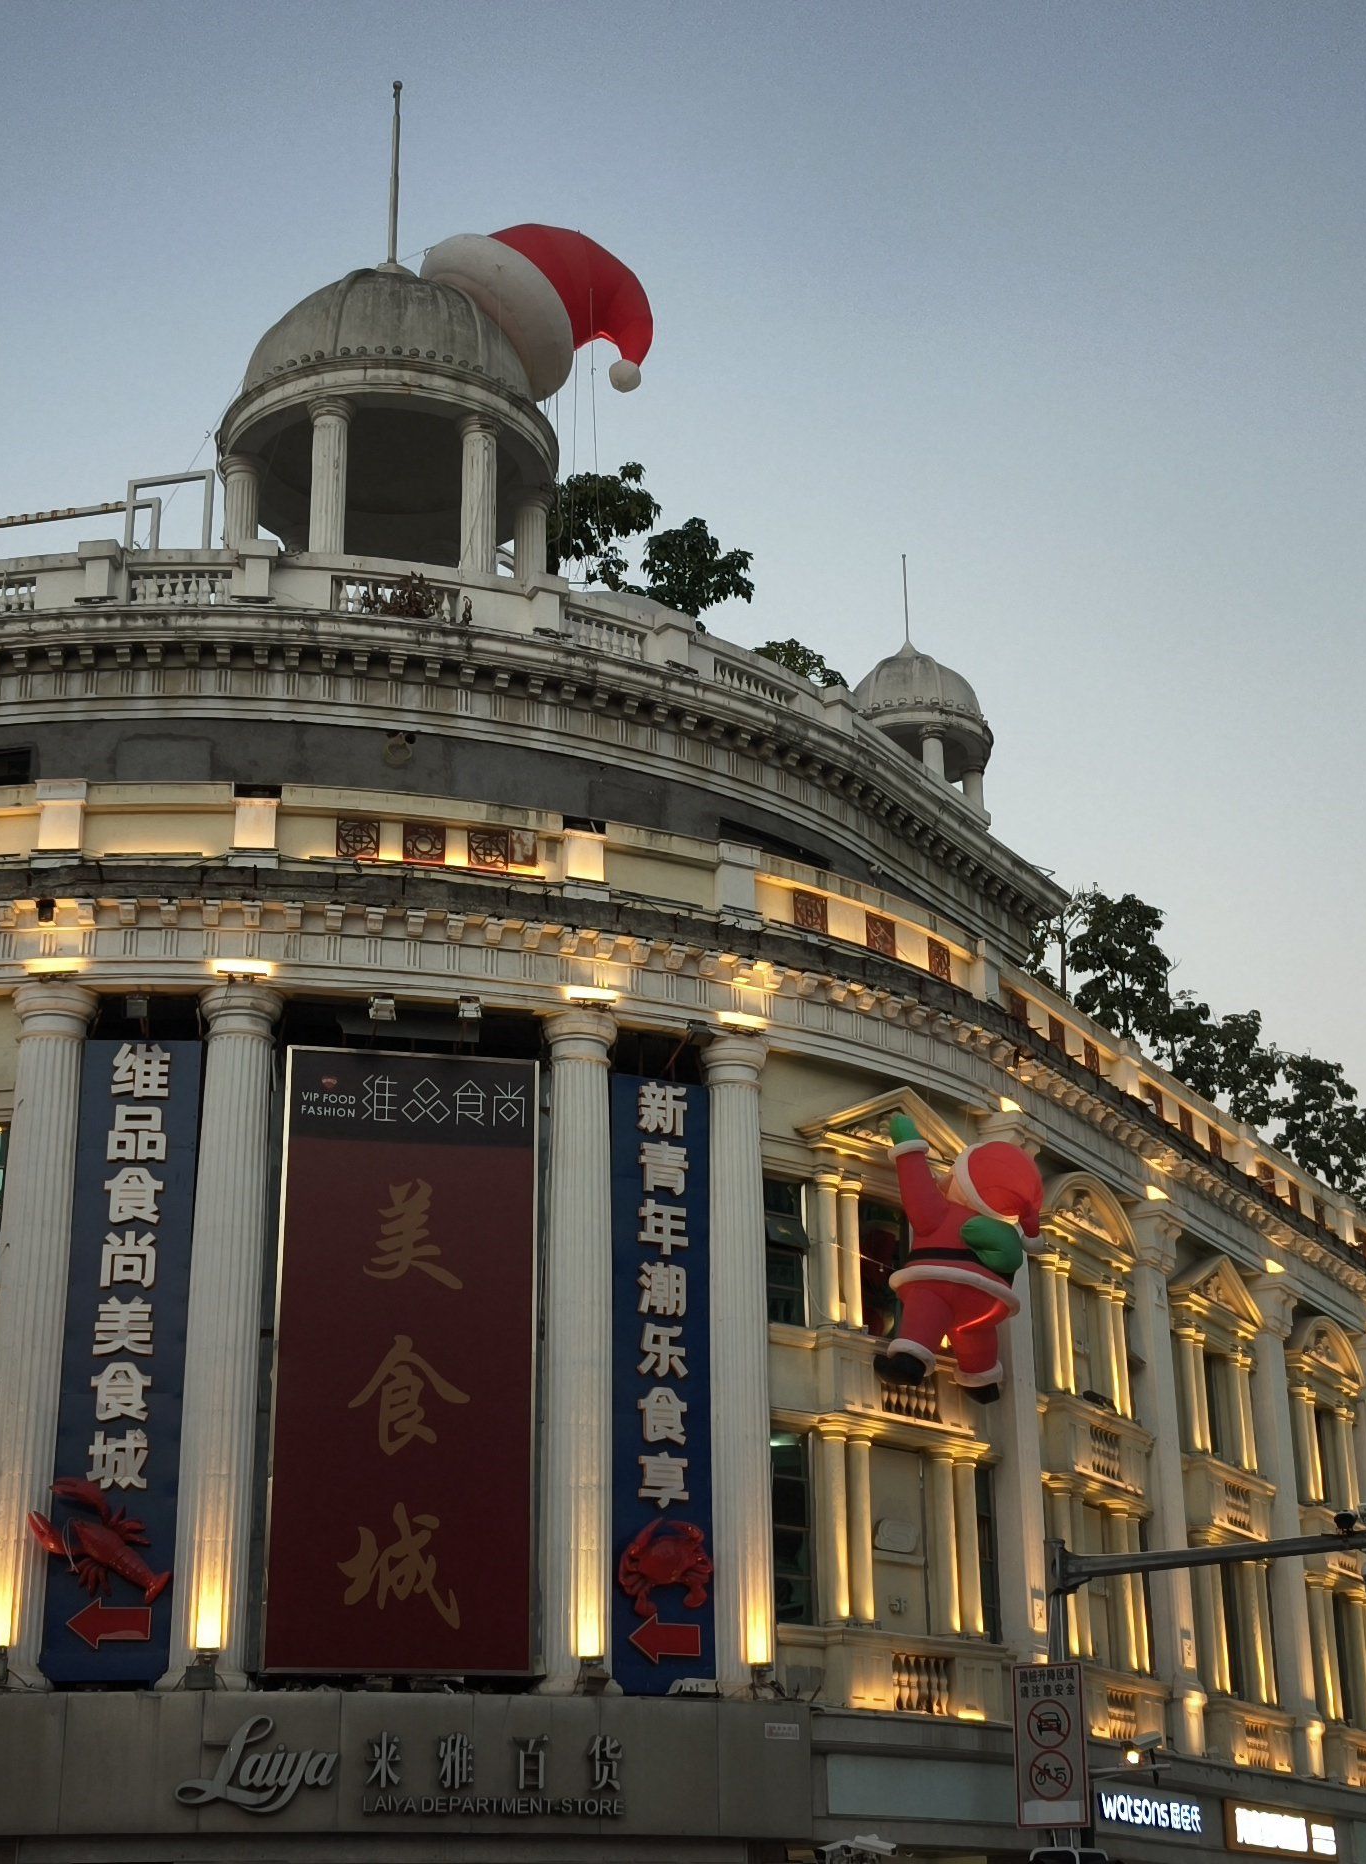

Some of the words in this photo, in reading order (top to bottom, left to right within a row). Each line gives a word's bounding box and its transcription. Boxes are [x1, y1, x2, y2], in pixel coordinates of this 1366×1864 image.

[301, 1091, 319, 1102] VIP
[322, 1093, 356, 1105] FOOD
[301, 1105, 356, 1118] FASHION
[361, 1074, 525, 1127] 维品食尚
[86, 1042, 171, 1490] 维品食尚美食城
[637, 1081, 689, 1510] 新青年潮乐食享
[337, 1178, 472, 1630] 美食城
[174, 1714, 338, 1813] Laiya
[366, 1730, 624, 1792] 来雅百货
[362, 1796, 416, 1815] LAIYA
